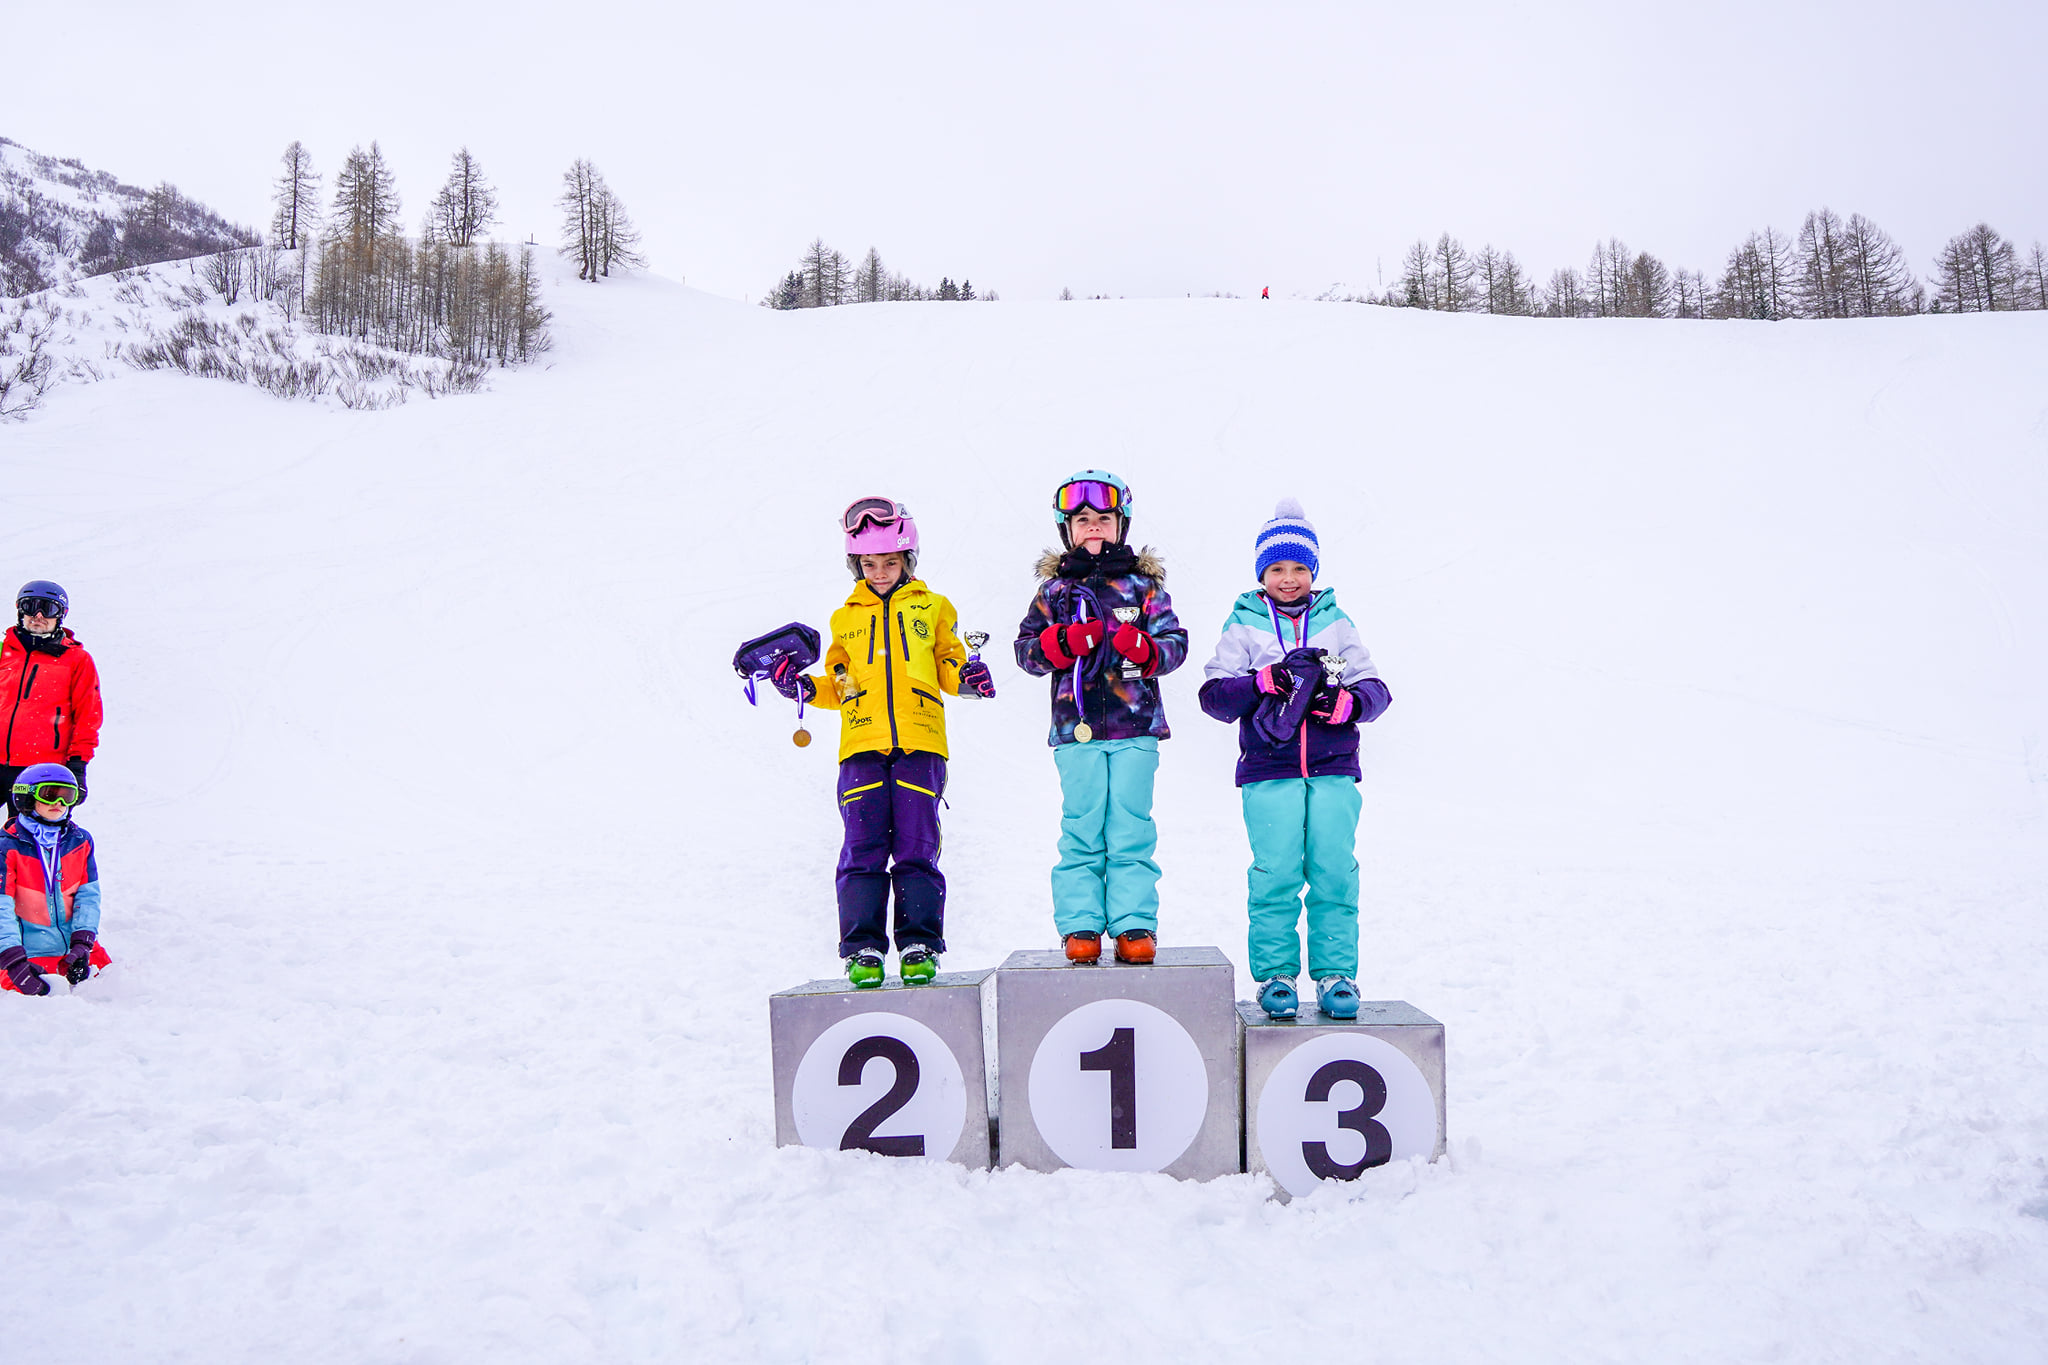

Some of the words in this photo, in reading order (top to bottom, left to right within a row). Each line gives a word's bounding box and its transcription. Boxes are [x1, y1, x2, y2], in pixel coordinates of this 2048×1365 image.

[840, 628, 866, 640] MBPI
[838, 1035, 926, 1157] 2
[1080, 1027, 1137, 1149] 1
[1301, 1059, 1393, 1181] 3
